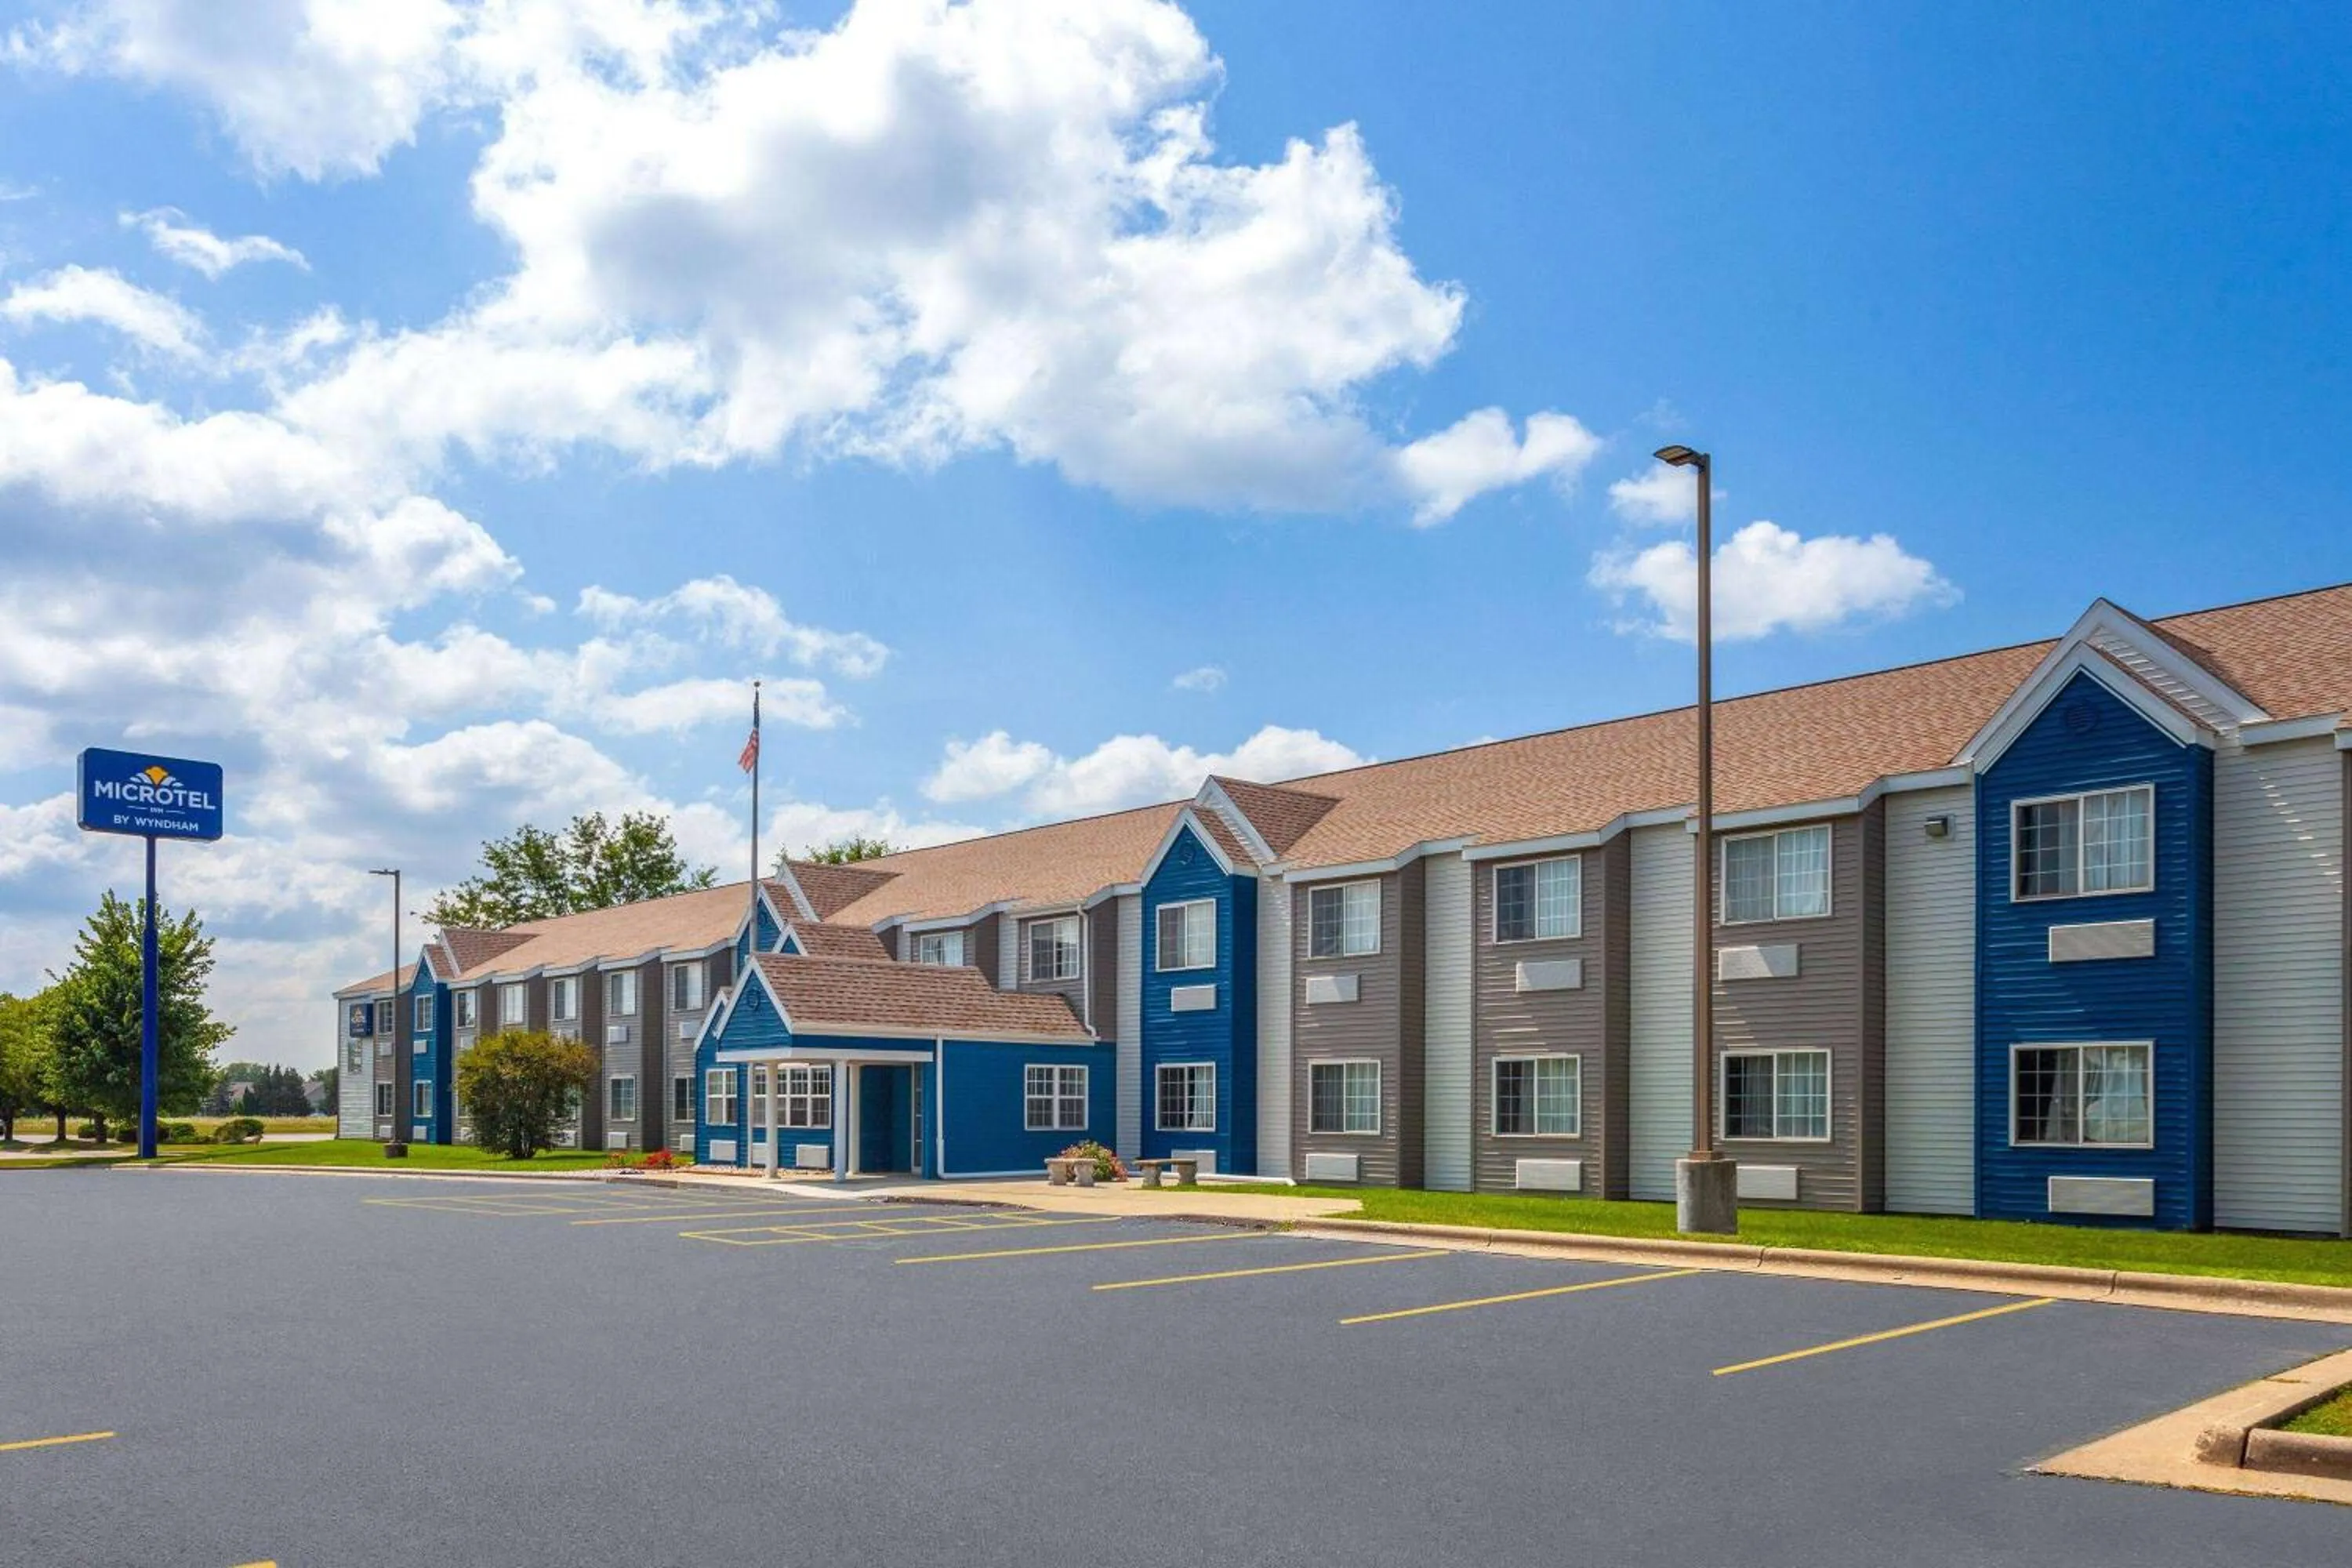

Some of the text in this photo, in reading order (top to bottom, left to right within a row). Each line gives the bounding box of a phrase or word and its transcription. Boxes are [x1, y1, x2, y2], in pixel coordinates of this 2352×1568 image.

[94, 780, 216, 811] MICROTEL
[114, 815, 199, 833] BY WYNDHAM
